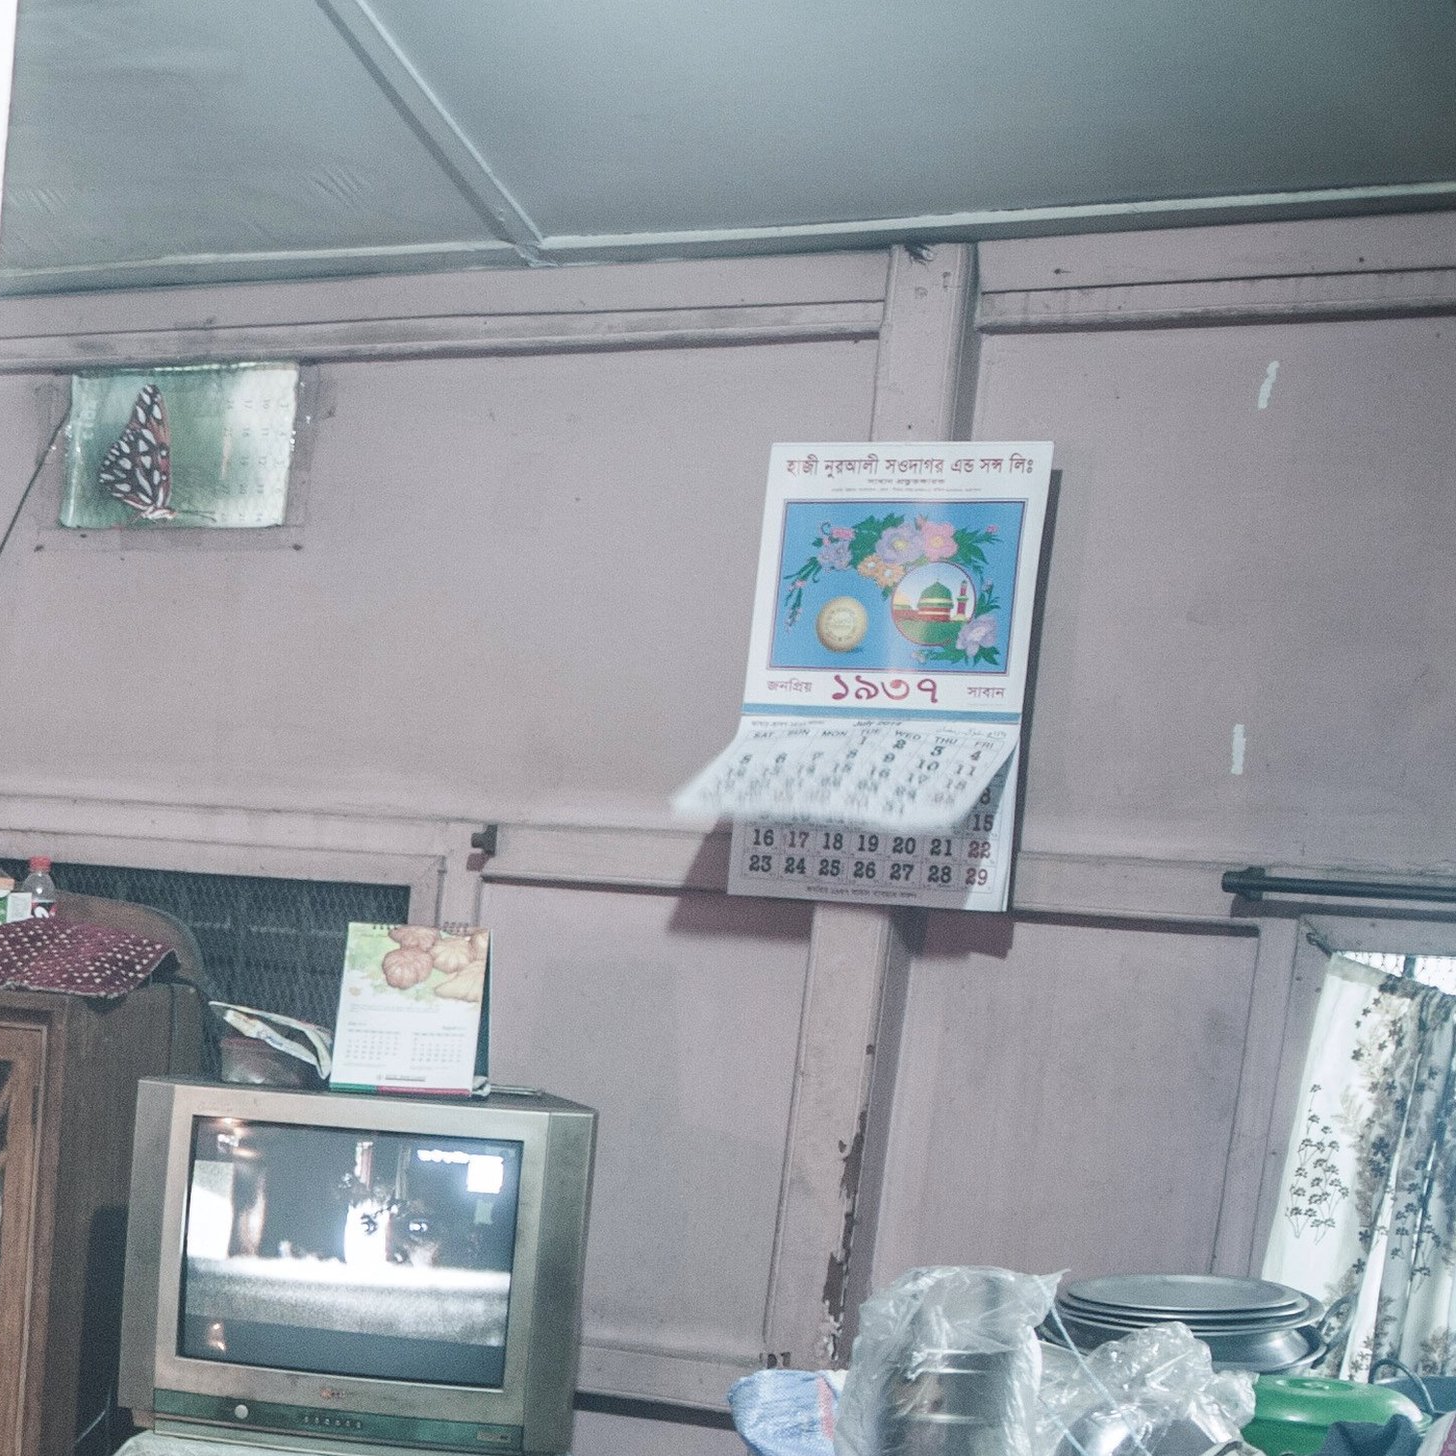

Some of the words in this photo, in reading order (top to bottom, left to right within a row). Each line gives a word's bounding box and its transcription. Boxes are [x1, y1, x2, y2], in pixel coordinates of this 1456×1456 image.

[786, 453, 819, 477] হাজী
[885, 457, 944, 476] সওদাগর
[1009, 452, 1034, 475] লিঃ
[831, 674, 939, 704] ১৯৩৭
[967, 685, 1006, 699] সাবান
[821, 729, 848, 737] MON
[895, 729, 922, 741] WED
[935, 735, 959, 745] THU
[974, 741, 994, 749] FRI
[893, 739, 906, 750] 2
[970, 750, 982, 761] 4
[918, 758, 940, 771] 10
[955, 763, 977, 777] 11
[973, 813, 994, 832] 15
[753, 828, 775, 847] 16
[789, 831, 810, 848] 17
[823, 832, 844, 850] 18
[857, 834, 879, 852] 19
[893, 836, 917, 855] 20
[929, 838, 953, 857] 21
[968, 840, 991, 859] 22
[749, 854, 773, 872] 23
[784, 856, 807, 875] 24
[818, 858, 841, 877] 25
[853, 861, 876, 879] 26
[890, 863, 915, 881] 27
[927, 865, 952, 884] 28
[965, 867, 989, 886] 29
